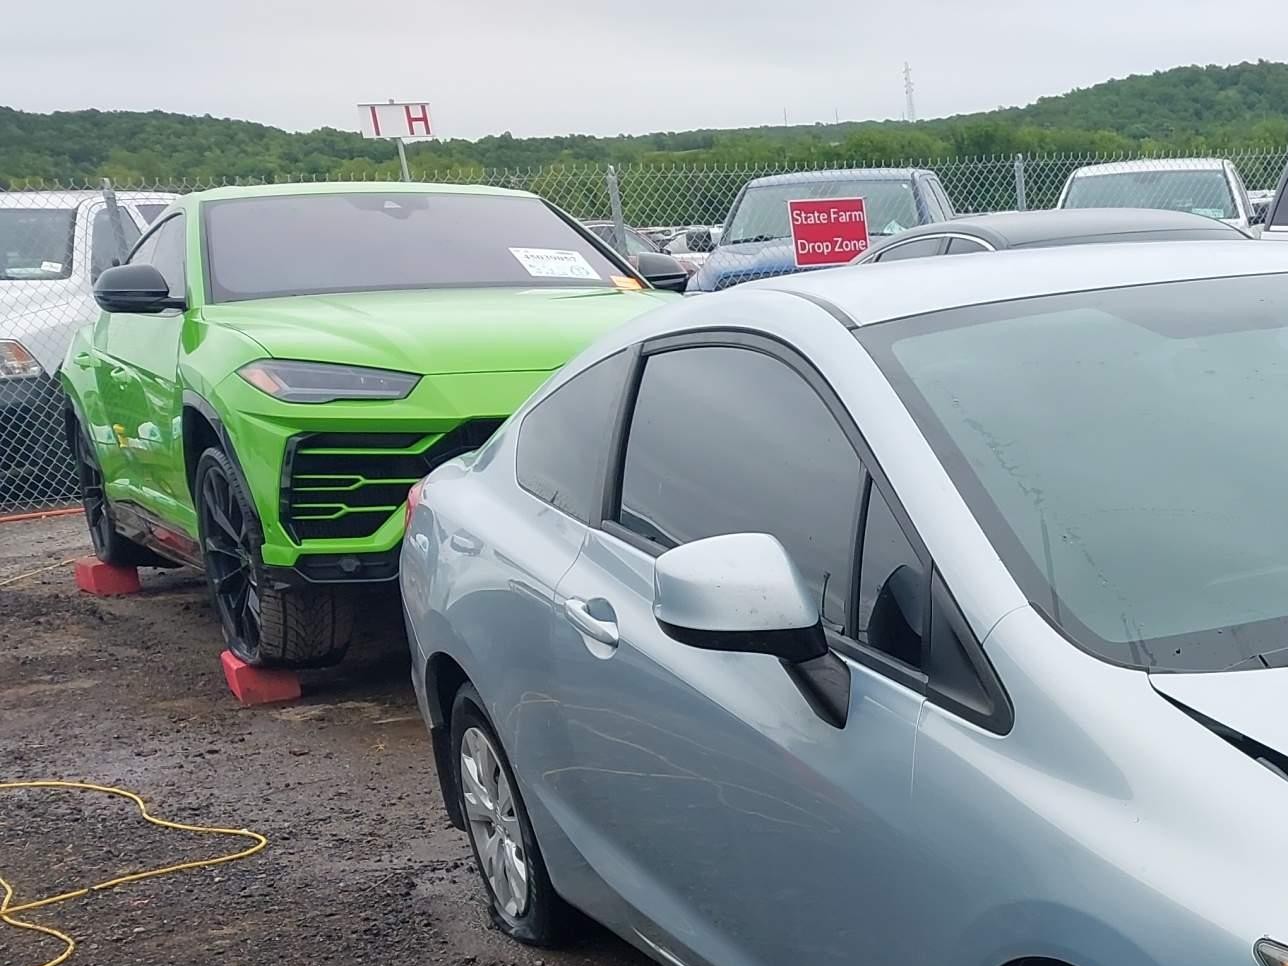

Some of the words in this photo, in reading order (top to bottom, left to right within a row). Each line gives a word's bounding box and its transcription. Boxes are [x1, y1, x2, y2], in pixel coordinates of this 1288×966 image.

[404, 105, 431, 135] H
[793, 210, 828, 225] State
[830, 208, 864, 223] Farm
[797, 239, 831, 256] Drop
[833, 237, 867, 252] Zone
